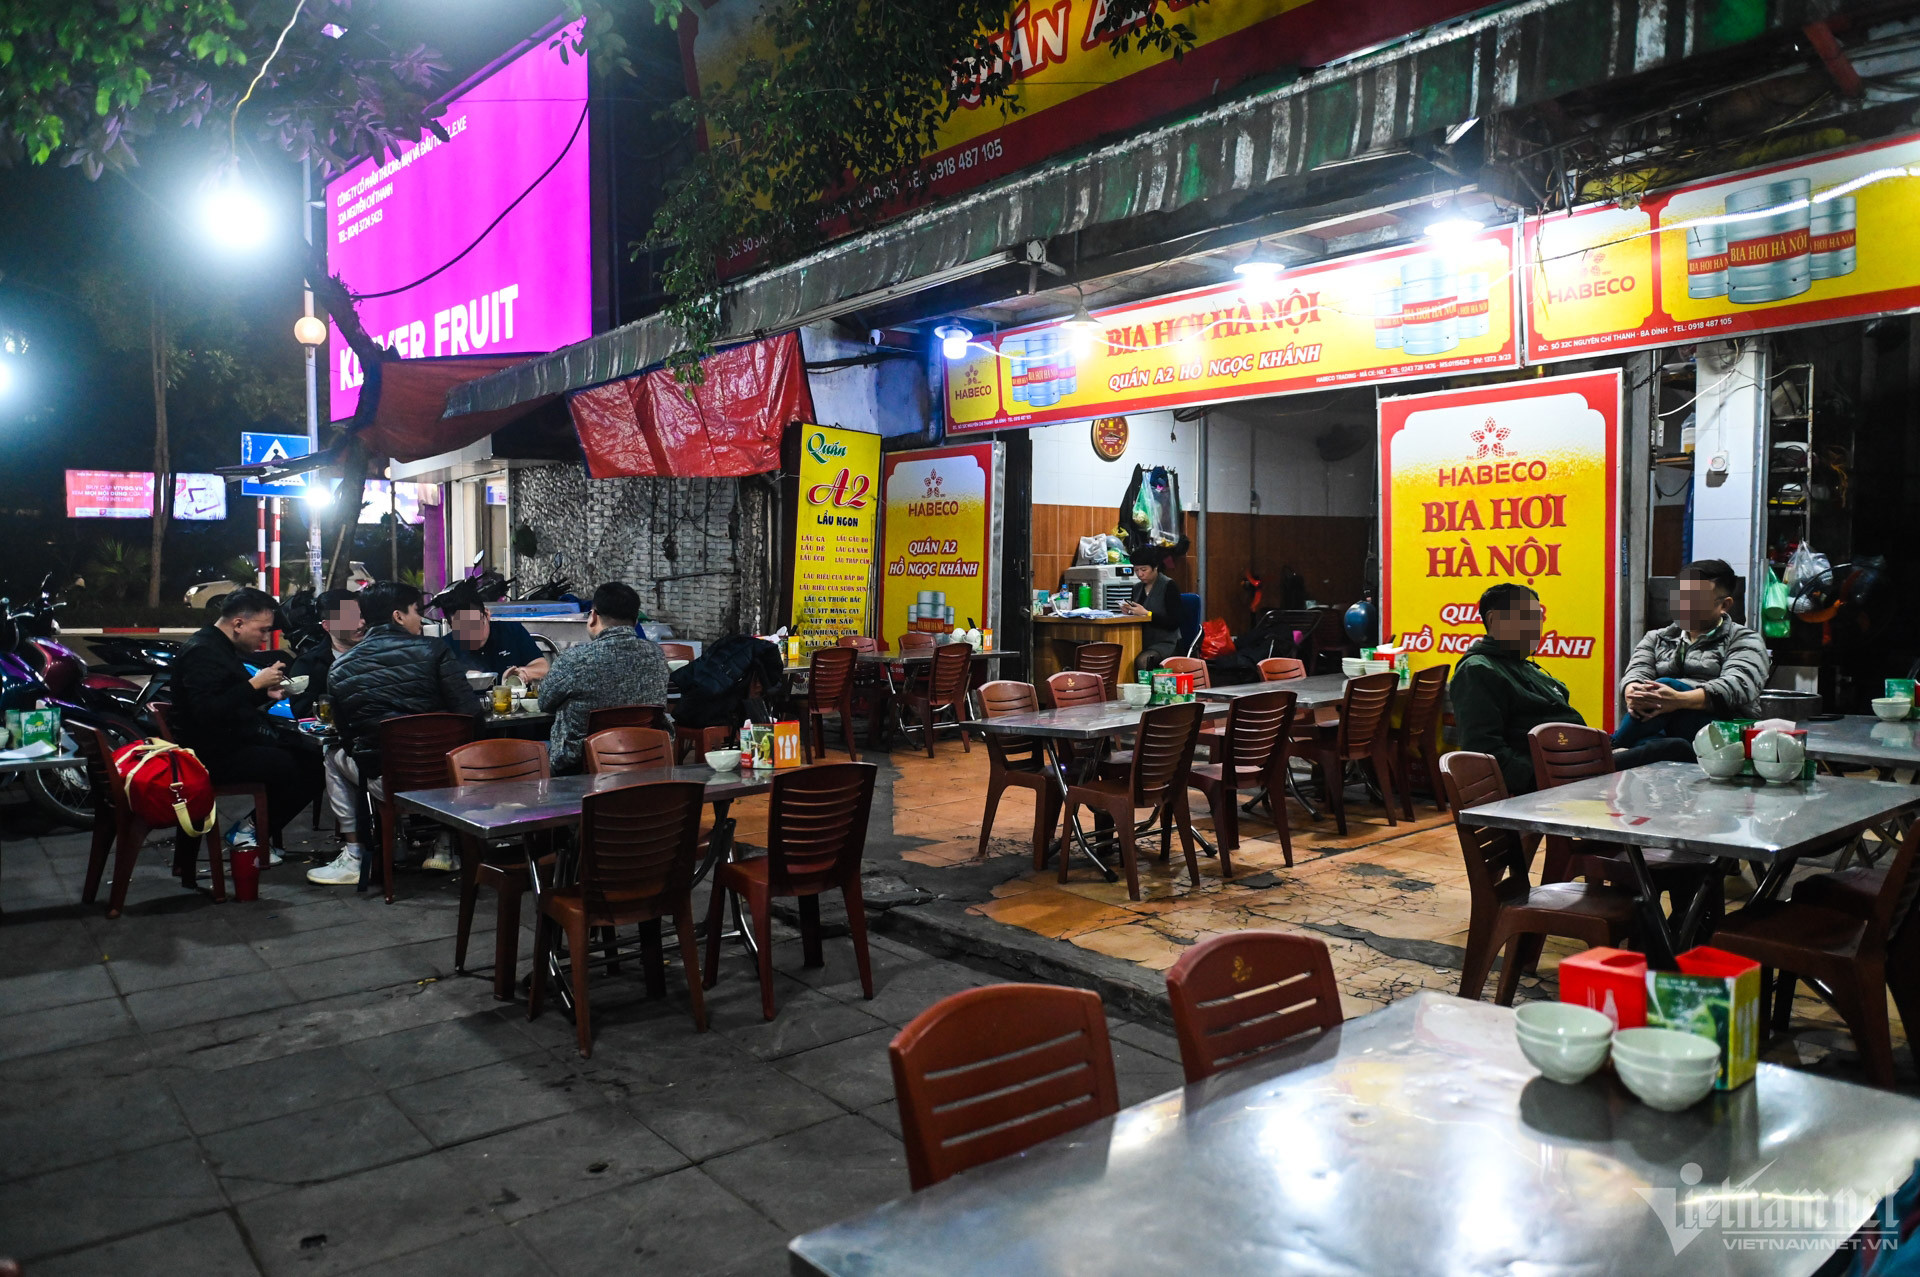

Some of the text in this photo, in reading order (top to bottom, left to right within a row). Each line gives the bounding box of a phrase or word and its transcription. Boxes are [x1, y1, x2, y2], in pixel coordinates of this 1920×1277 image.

[958, 147, 979, 171] 487
[981, 138, 1003, 162] 105
[1730, 247, 1746, 262] BIA
[1771, 235, 1787, 257] HÀ
[1547, 275, 1636, 304] HABECO
[434, 283, 519, 357] FRUIT
[1105, 324, 1149, 357] BIA
[1210, 297, 1259, 340] HÀ
[1259, 287, 1322, 335] NỘI
[1601, 333, 1612, 344] CHÍ
[1613, 331, 1636, 341] THANH
[1640, 329, 1651, 338] BA
[1651, 326, 1669, 337] ĐÌNH
[1673, 324, 1688, 333] TEL:
[1688, 321, 1705, 331] 0918
[1706, 319, 1720, 329] 487
[1720, 317, 1733, 326] 105
[1109, 342, 1323, 392] QUÁN A2 HỒ NGỌC KHÁNH
[955, 385, 992, 401] HABECO
[807, 432, 847, 464] Quán
[1439, 460, 1547, 487] HABECO
[807, 468, 870, 509] A2
[817, 509, 859, 527] LẨU NGON
[908, 500, 959, 518] HABECO
[1421, 493, 1567, 533] BIA HƠI
[908, 537, 958, 555] QUÁN A2
[1426, 536, 1562, 585] HÀ NỘI
[888, 556, 980, 580] HỒ NGỌC KHÁNH
[1402, 626, 1433, 651] HỒ
[1536, 633, 1592, 656] ÁNH
